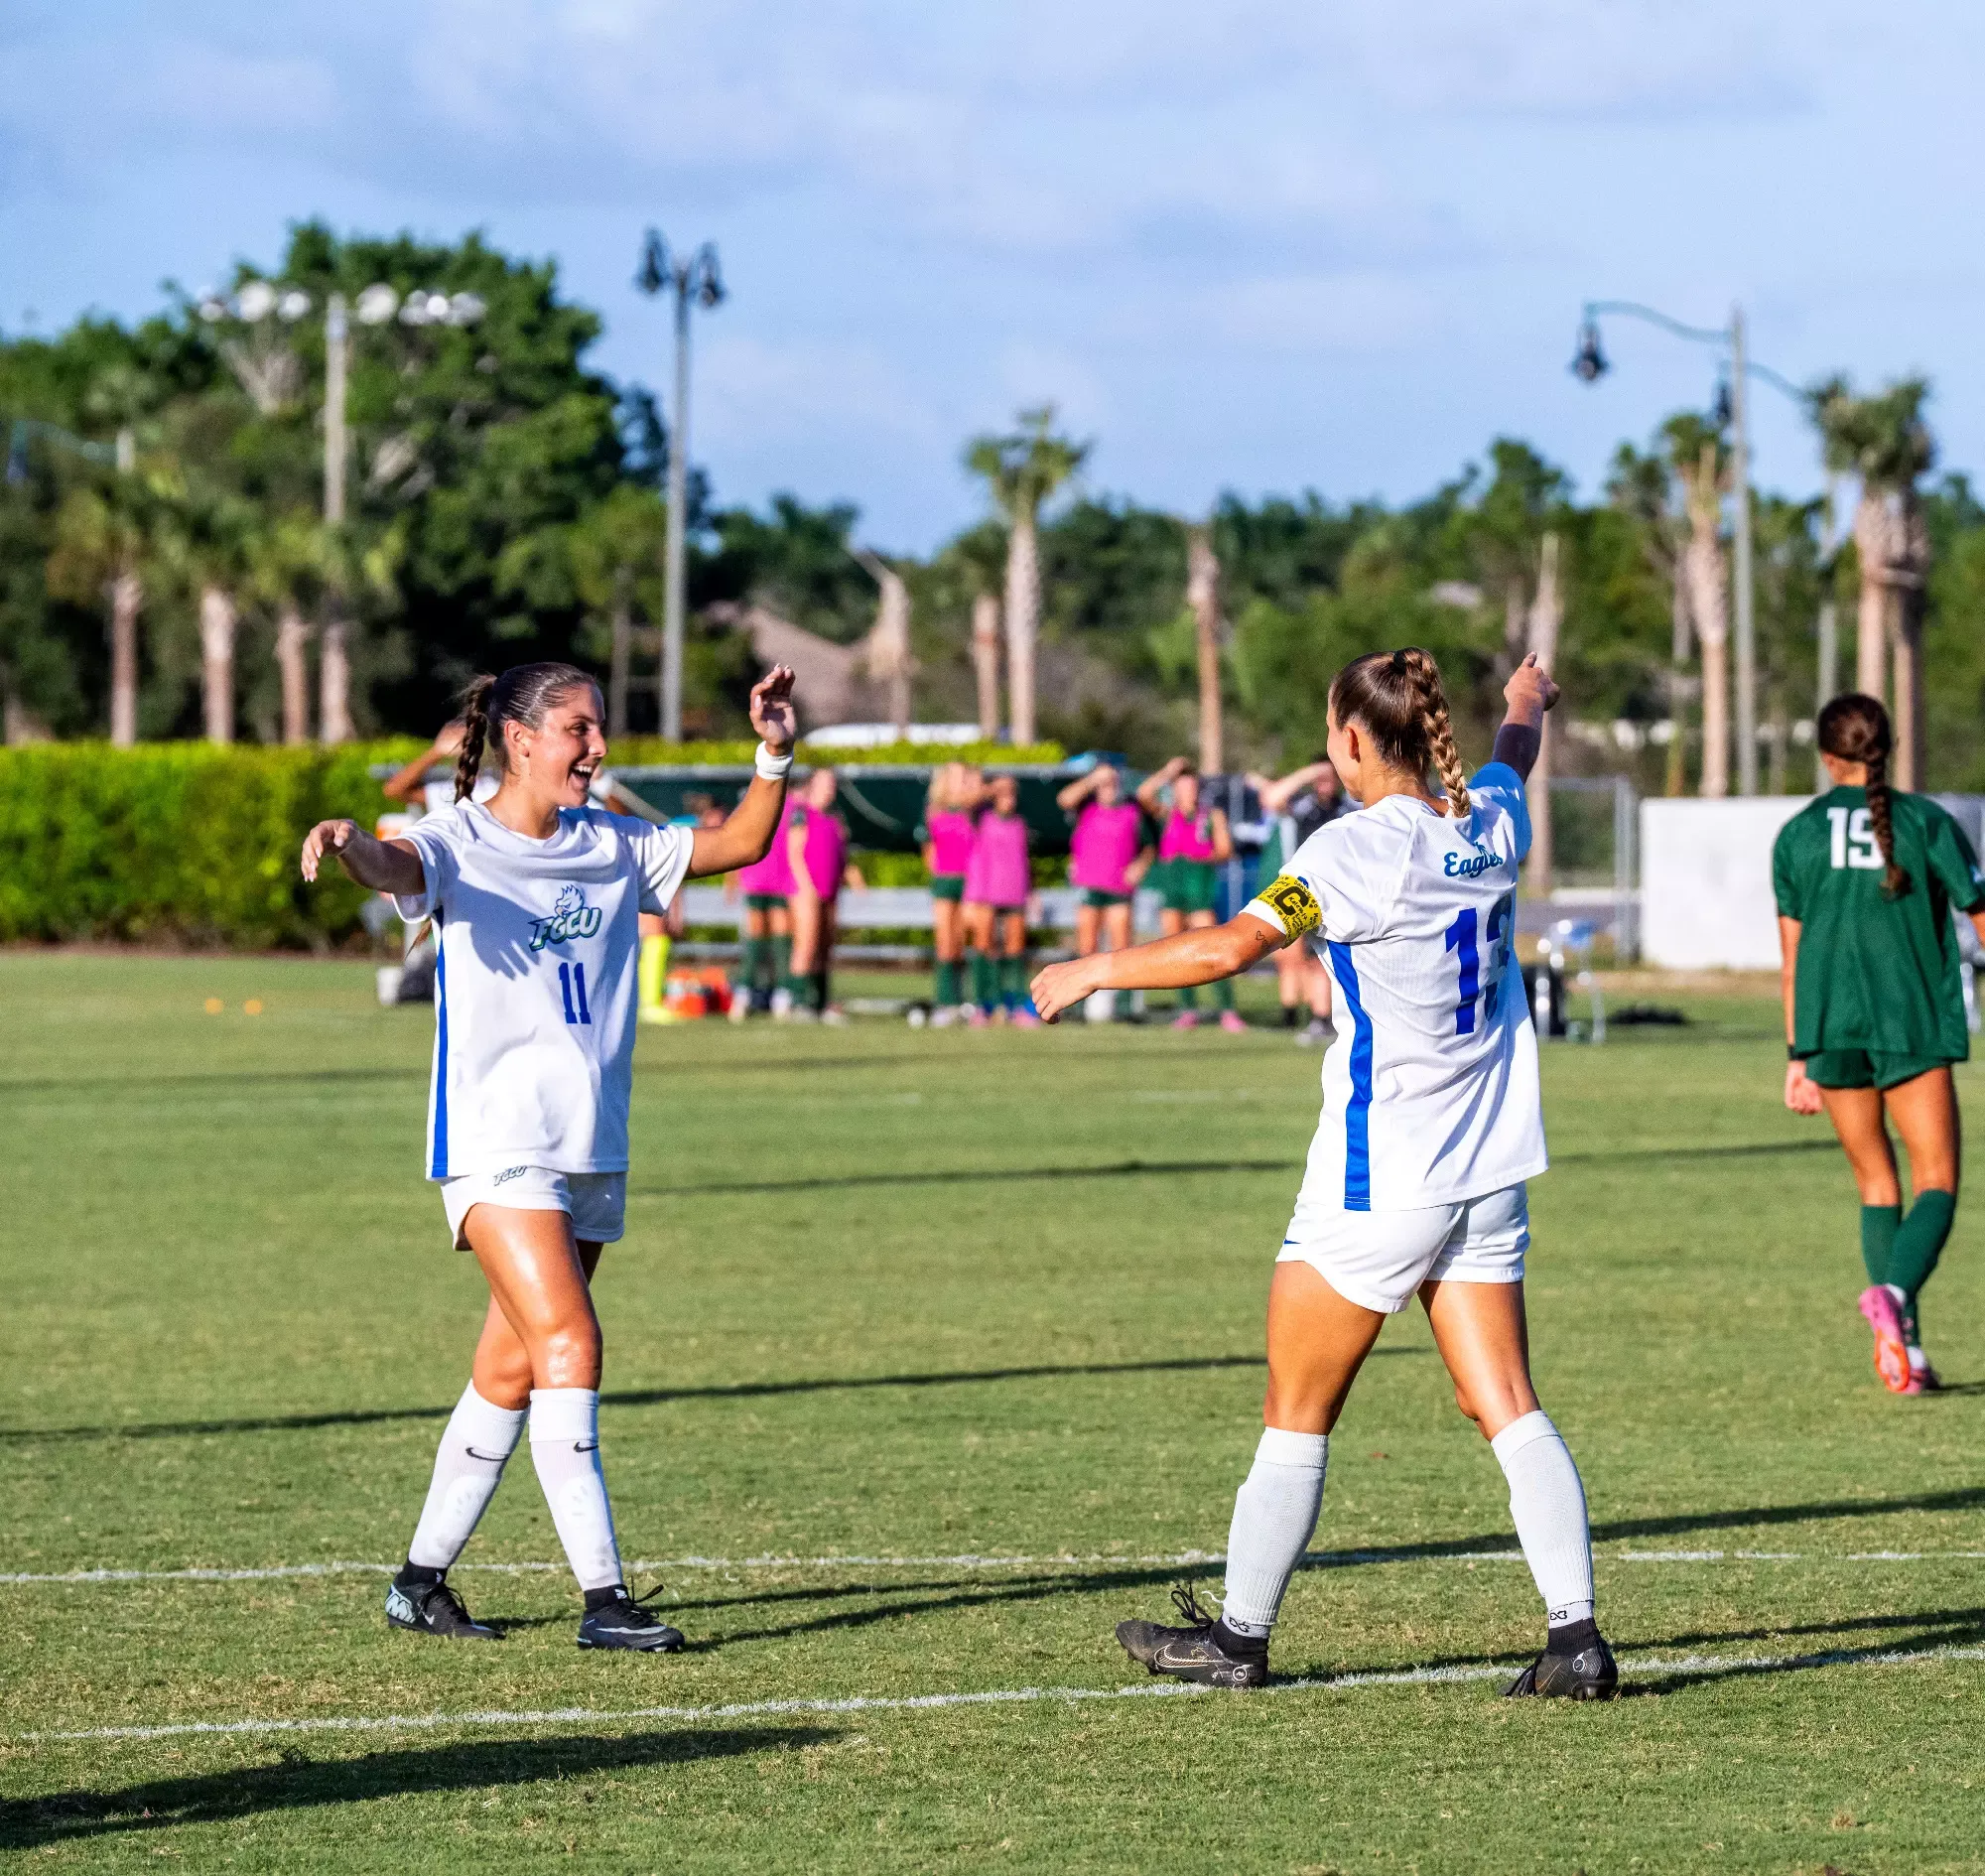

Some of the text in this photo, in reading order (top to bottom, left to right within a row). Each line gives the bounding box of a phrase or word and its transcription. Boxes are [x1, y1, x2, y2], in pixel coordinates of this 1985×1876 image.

[1443, 850, 1504, 878] Eagles
[1274, 886, 1309, 915] C
[528, 907, 601, 952] FGCU
[1445, 895, 1513, 1034] 13
[558, 962, 592, 1024] 11
